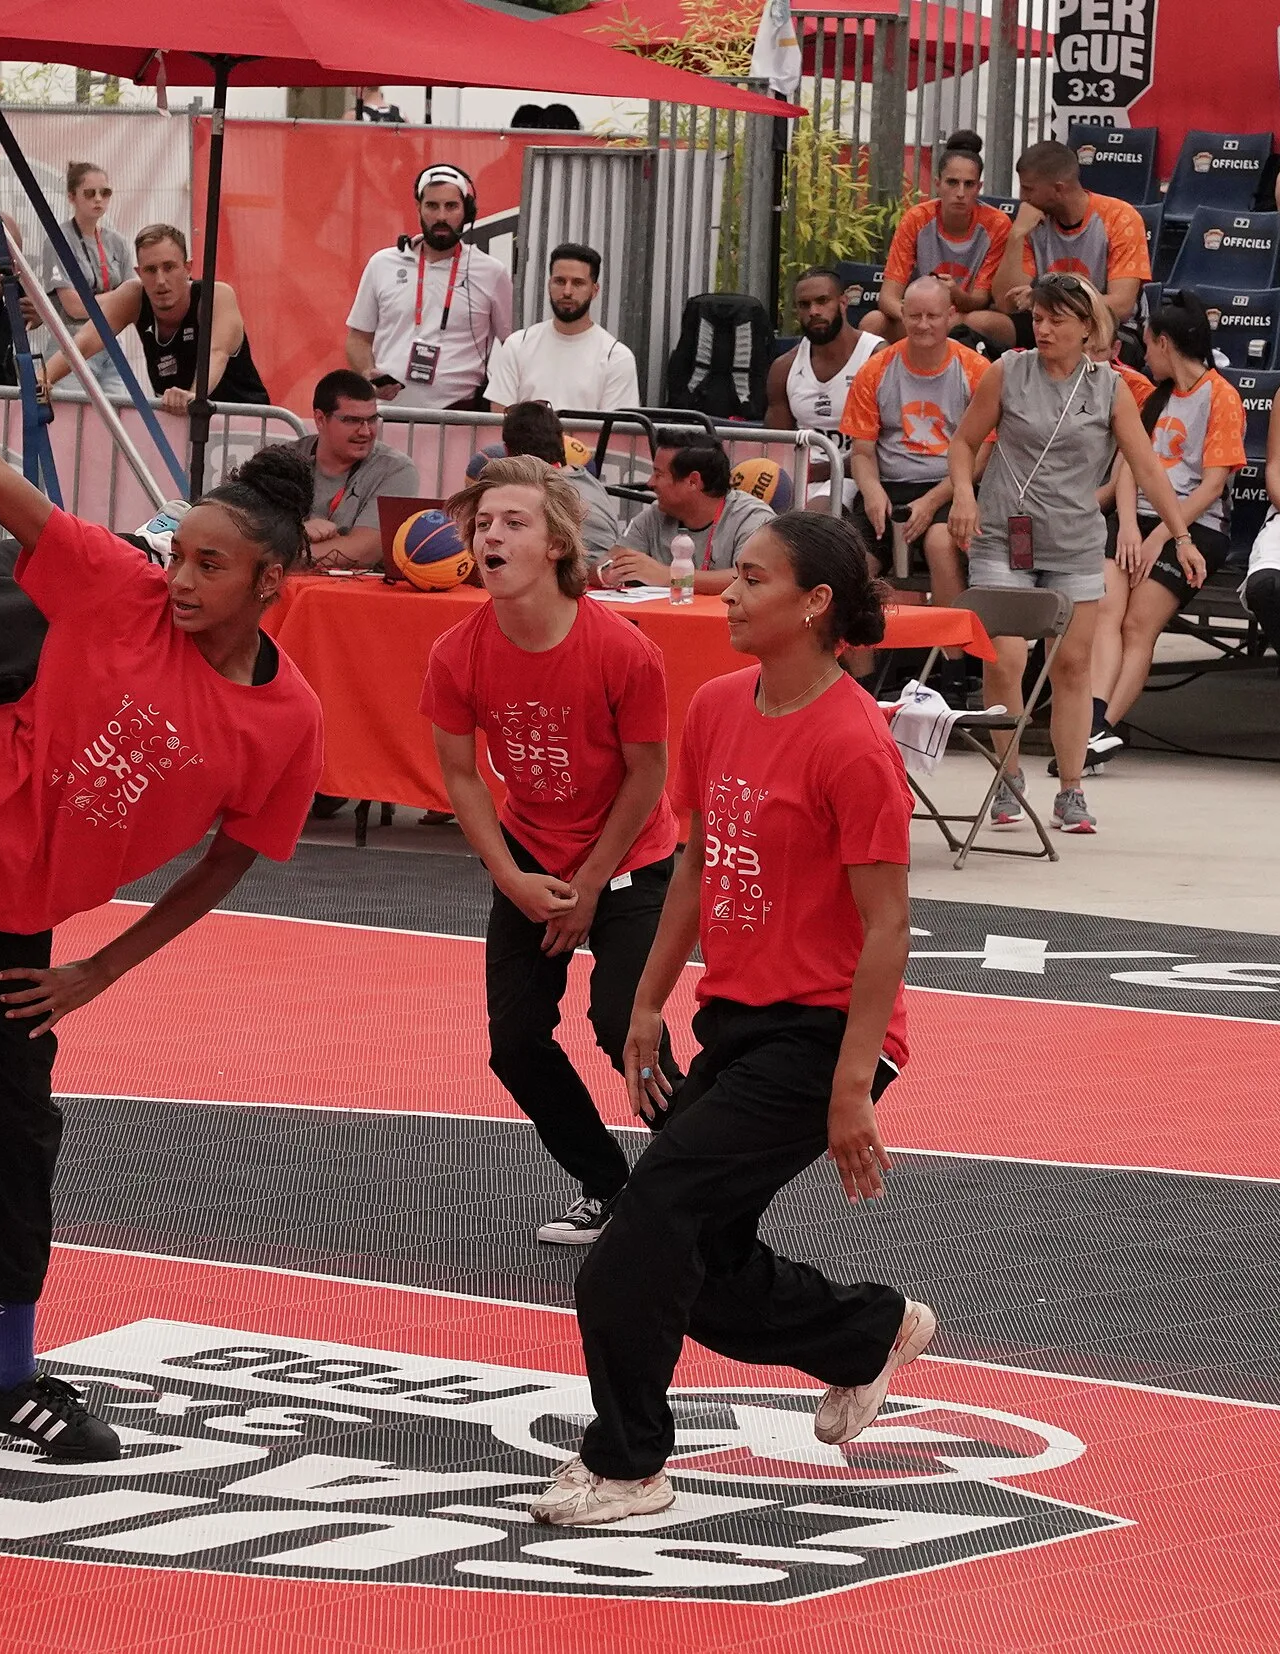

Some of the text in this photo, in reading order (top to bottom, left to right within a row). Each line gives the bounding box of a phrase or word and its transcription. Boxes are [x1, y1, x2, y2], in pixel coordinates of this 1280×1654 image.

[1055, 0, 1145, 35] PER
[1053, 34, 1145, 80] GUE
[1067, 78, 1116, 103] 3x3
[1095, 151, 1143, 164] OFFICIELS
[1212, 158, 1260, 170] OFFICIELS
[1223, 236, 1272, 250] OFFICIELS
[1220, 314, 1271, 327] OFFICIELS
[1242, 398, 1272, 411] AYER
[1230, 487, 1269, 501] LAYE
[159, 1345, 556, 1406] FFBB
